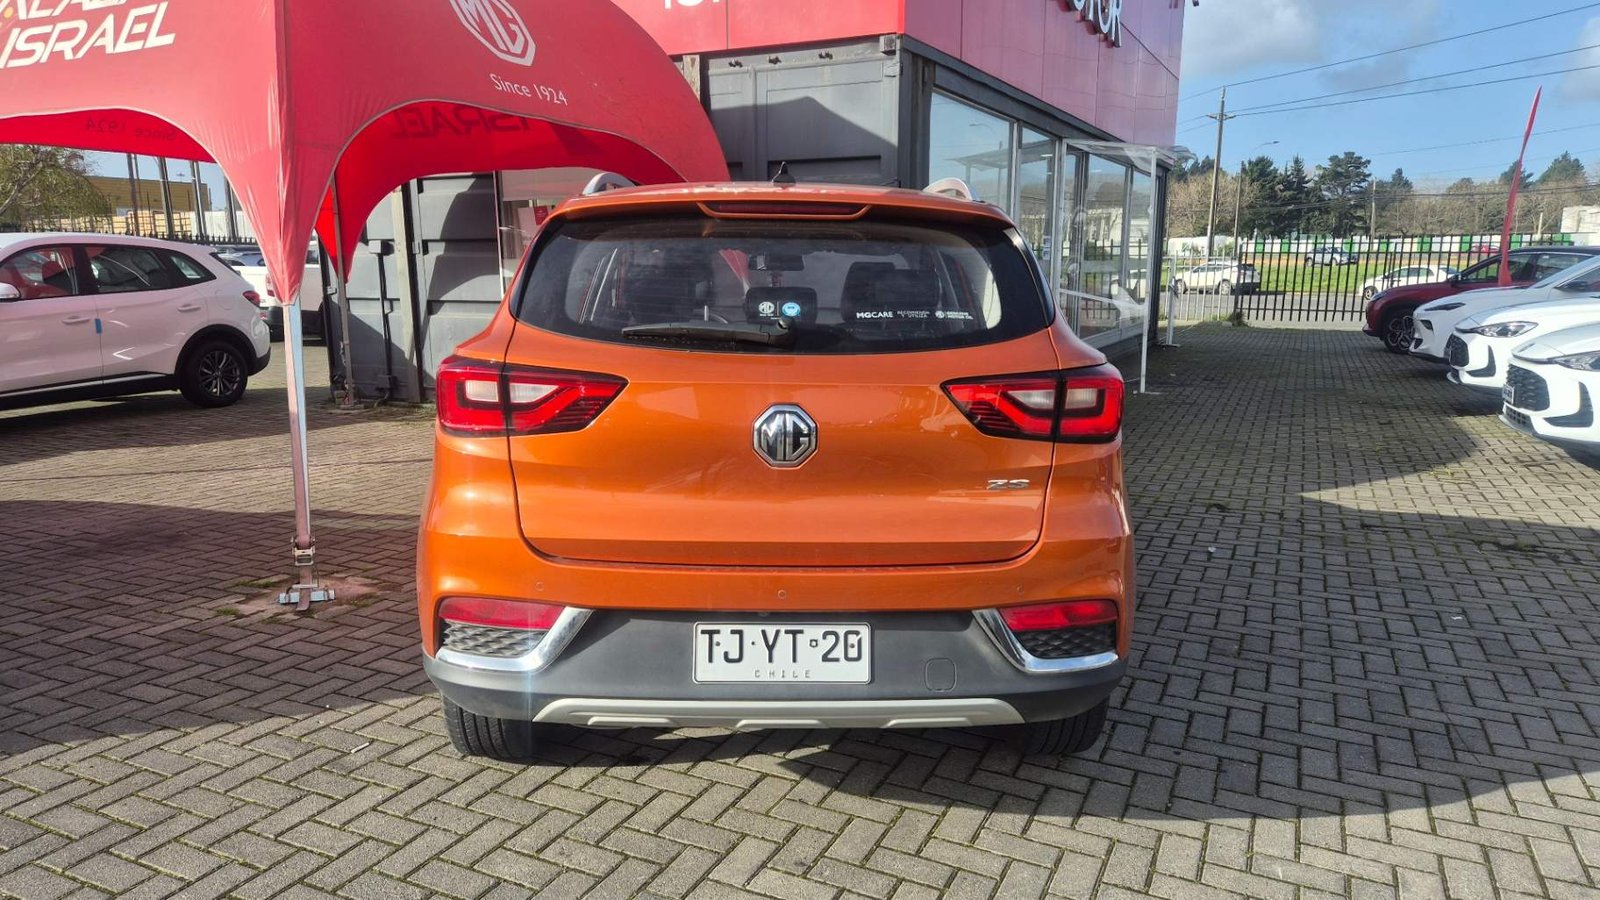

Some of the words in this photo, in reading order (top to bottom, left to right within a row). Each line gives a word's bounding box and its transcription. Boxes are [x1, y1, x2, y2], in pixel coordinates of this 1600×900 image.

[0, 1, 176, 69] ISRAEL
[489, 73, 532, 97] Since
[533, 83, 568, 106] 1924
[757, 408, 814, 464] MG
[754, 669, 812, 679] CHILE
